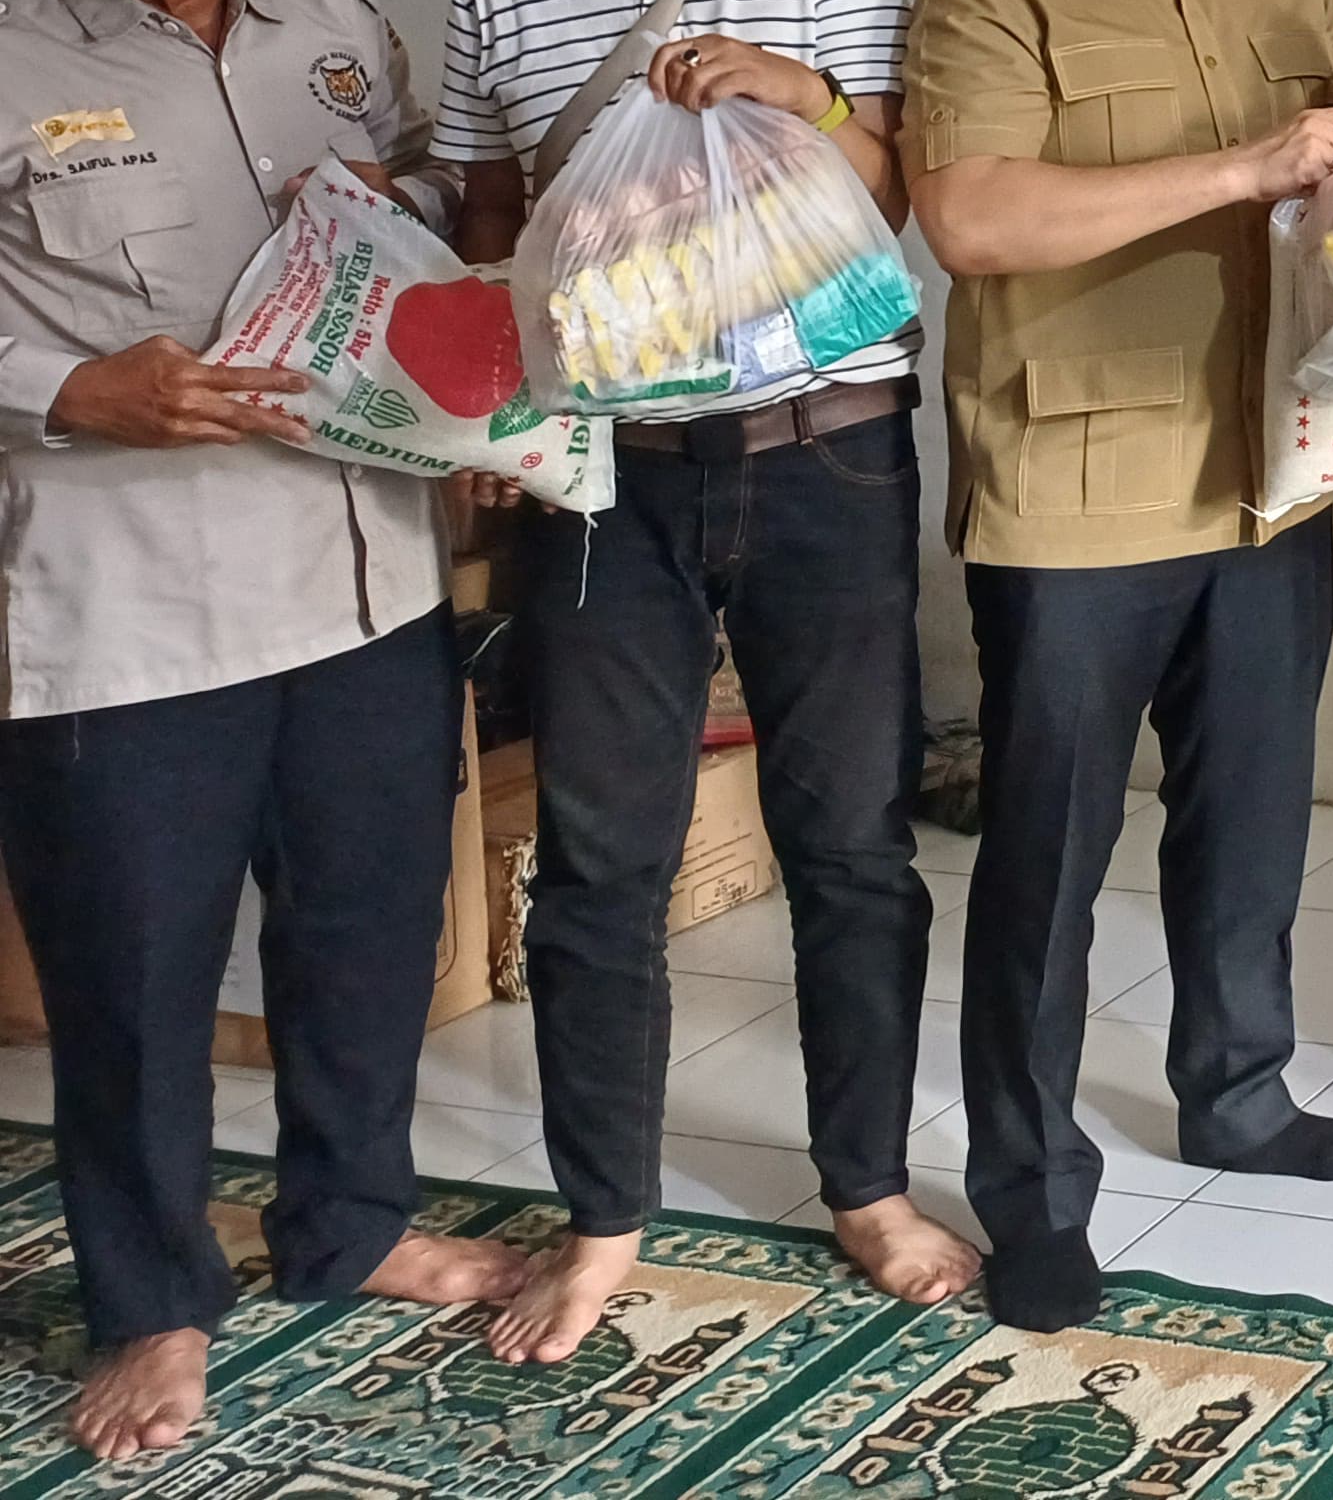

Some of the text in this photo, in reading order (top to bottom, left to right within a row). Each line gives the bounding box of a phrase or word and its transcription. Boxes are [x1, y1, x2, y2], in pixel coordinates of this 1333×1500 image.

[32, 151, 158, 184] Drs. SAIFUL APAS
[342, 240, 374, 305] BERAS
[362, 273, 392, 316] Netto
[316, 420, 455, 471] MEDIUM
